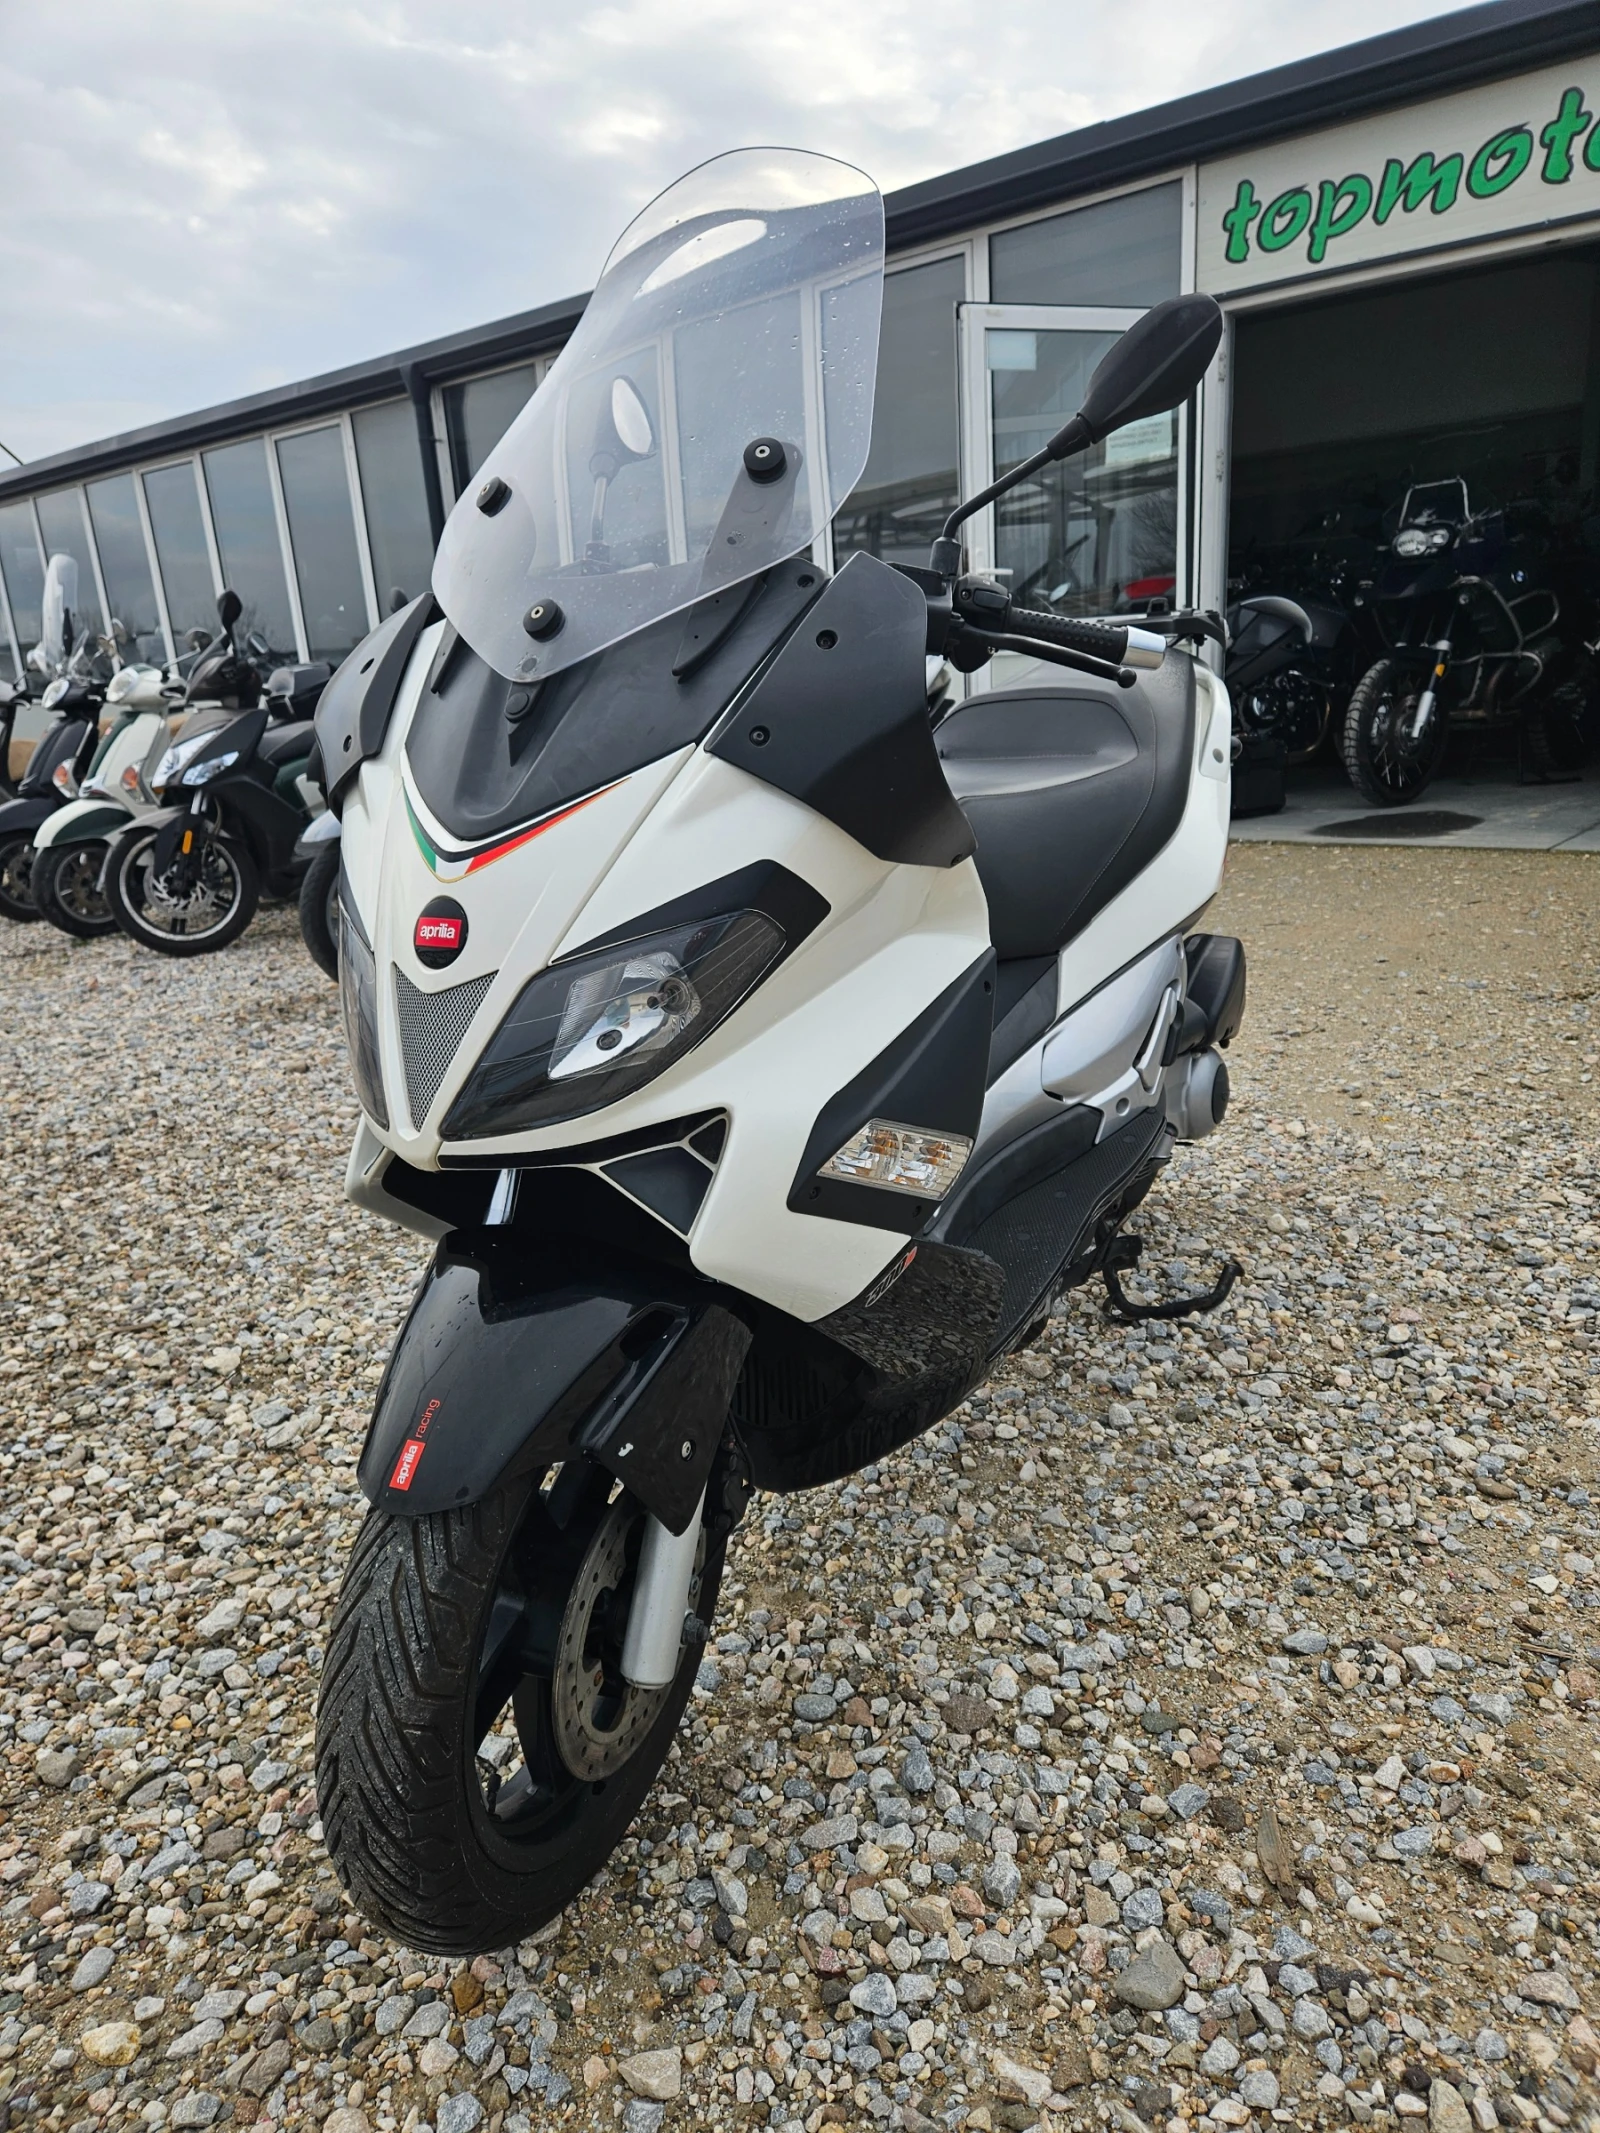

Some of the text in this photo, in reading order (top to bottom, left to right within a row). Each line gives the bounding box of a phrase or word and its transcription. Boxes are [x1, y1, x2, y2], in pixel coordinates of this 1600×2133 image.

[420, 923, 456, 939] aprilia
[396, 1399, 440, 1485] aprilia racing
